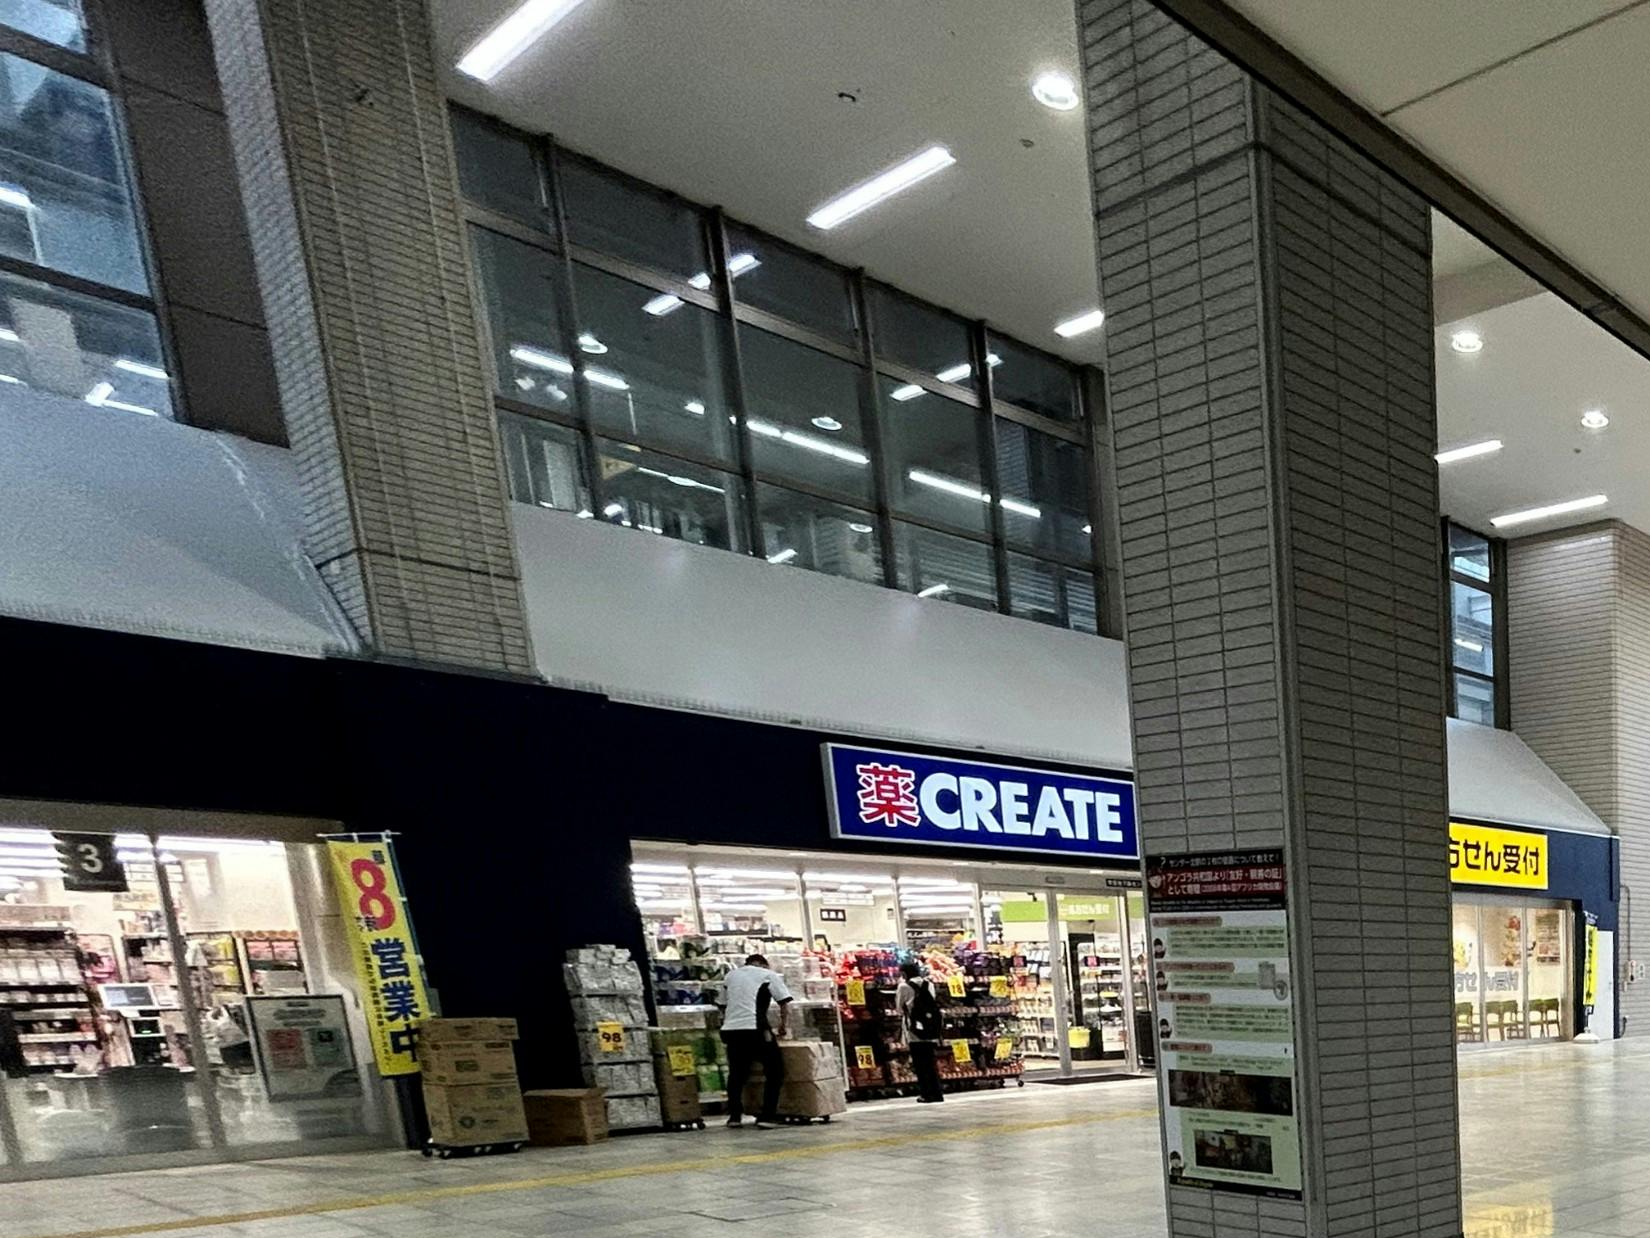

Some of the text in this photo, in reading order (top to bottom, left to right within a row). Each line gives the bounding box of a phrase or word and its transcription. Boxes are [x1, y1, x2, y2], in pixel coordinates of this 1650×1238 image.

[919, 772, 1123, 843] CREATE
[78, 843, 103, 873] 3
[351, 858, 396, 931] 8
[371, 937, 421, 1063] 営業中
[602, 1032, 622, 1043] 98
